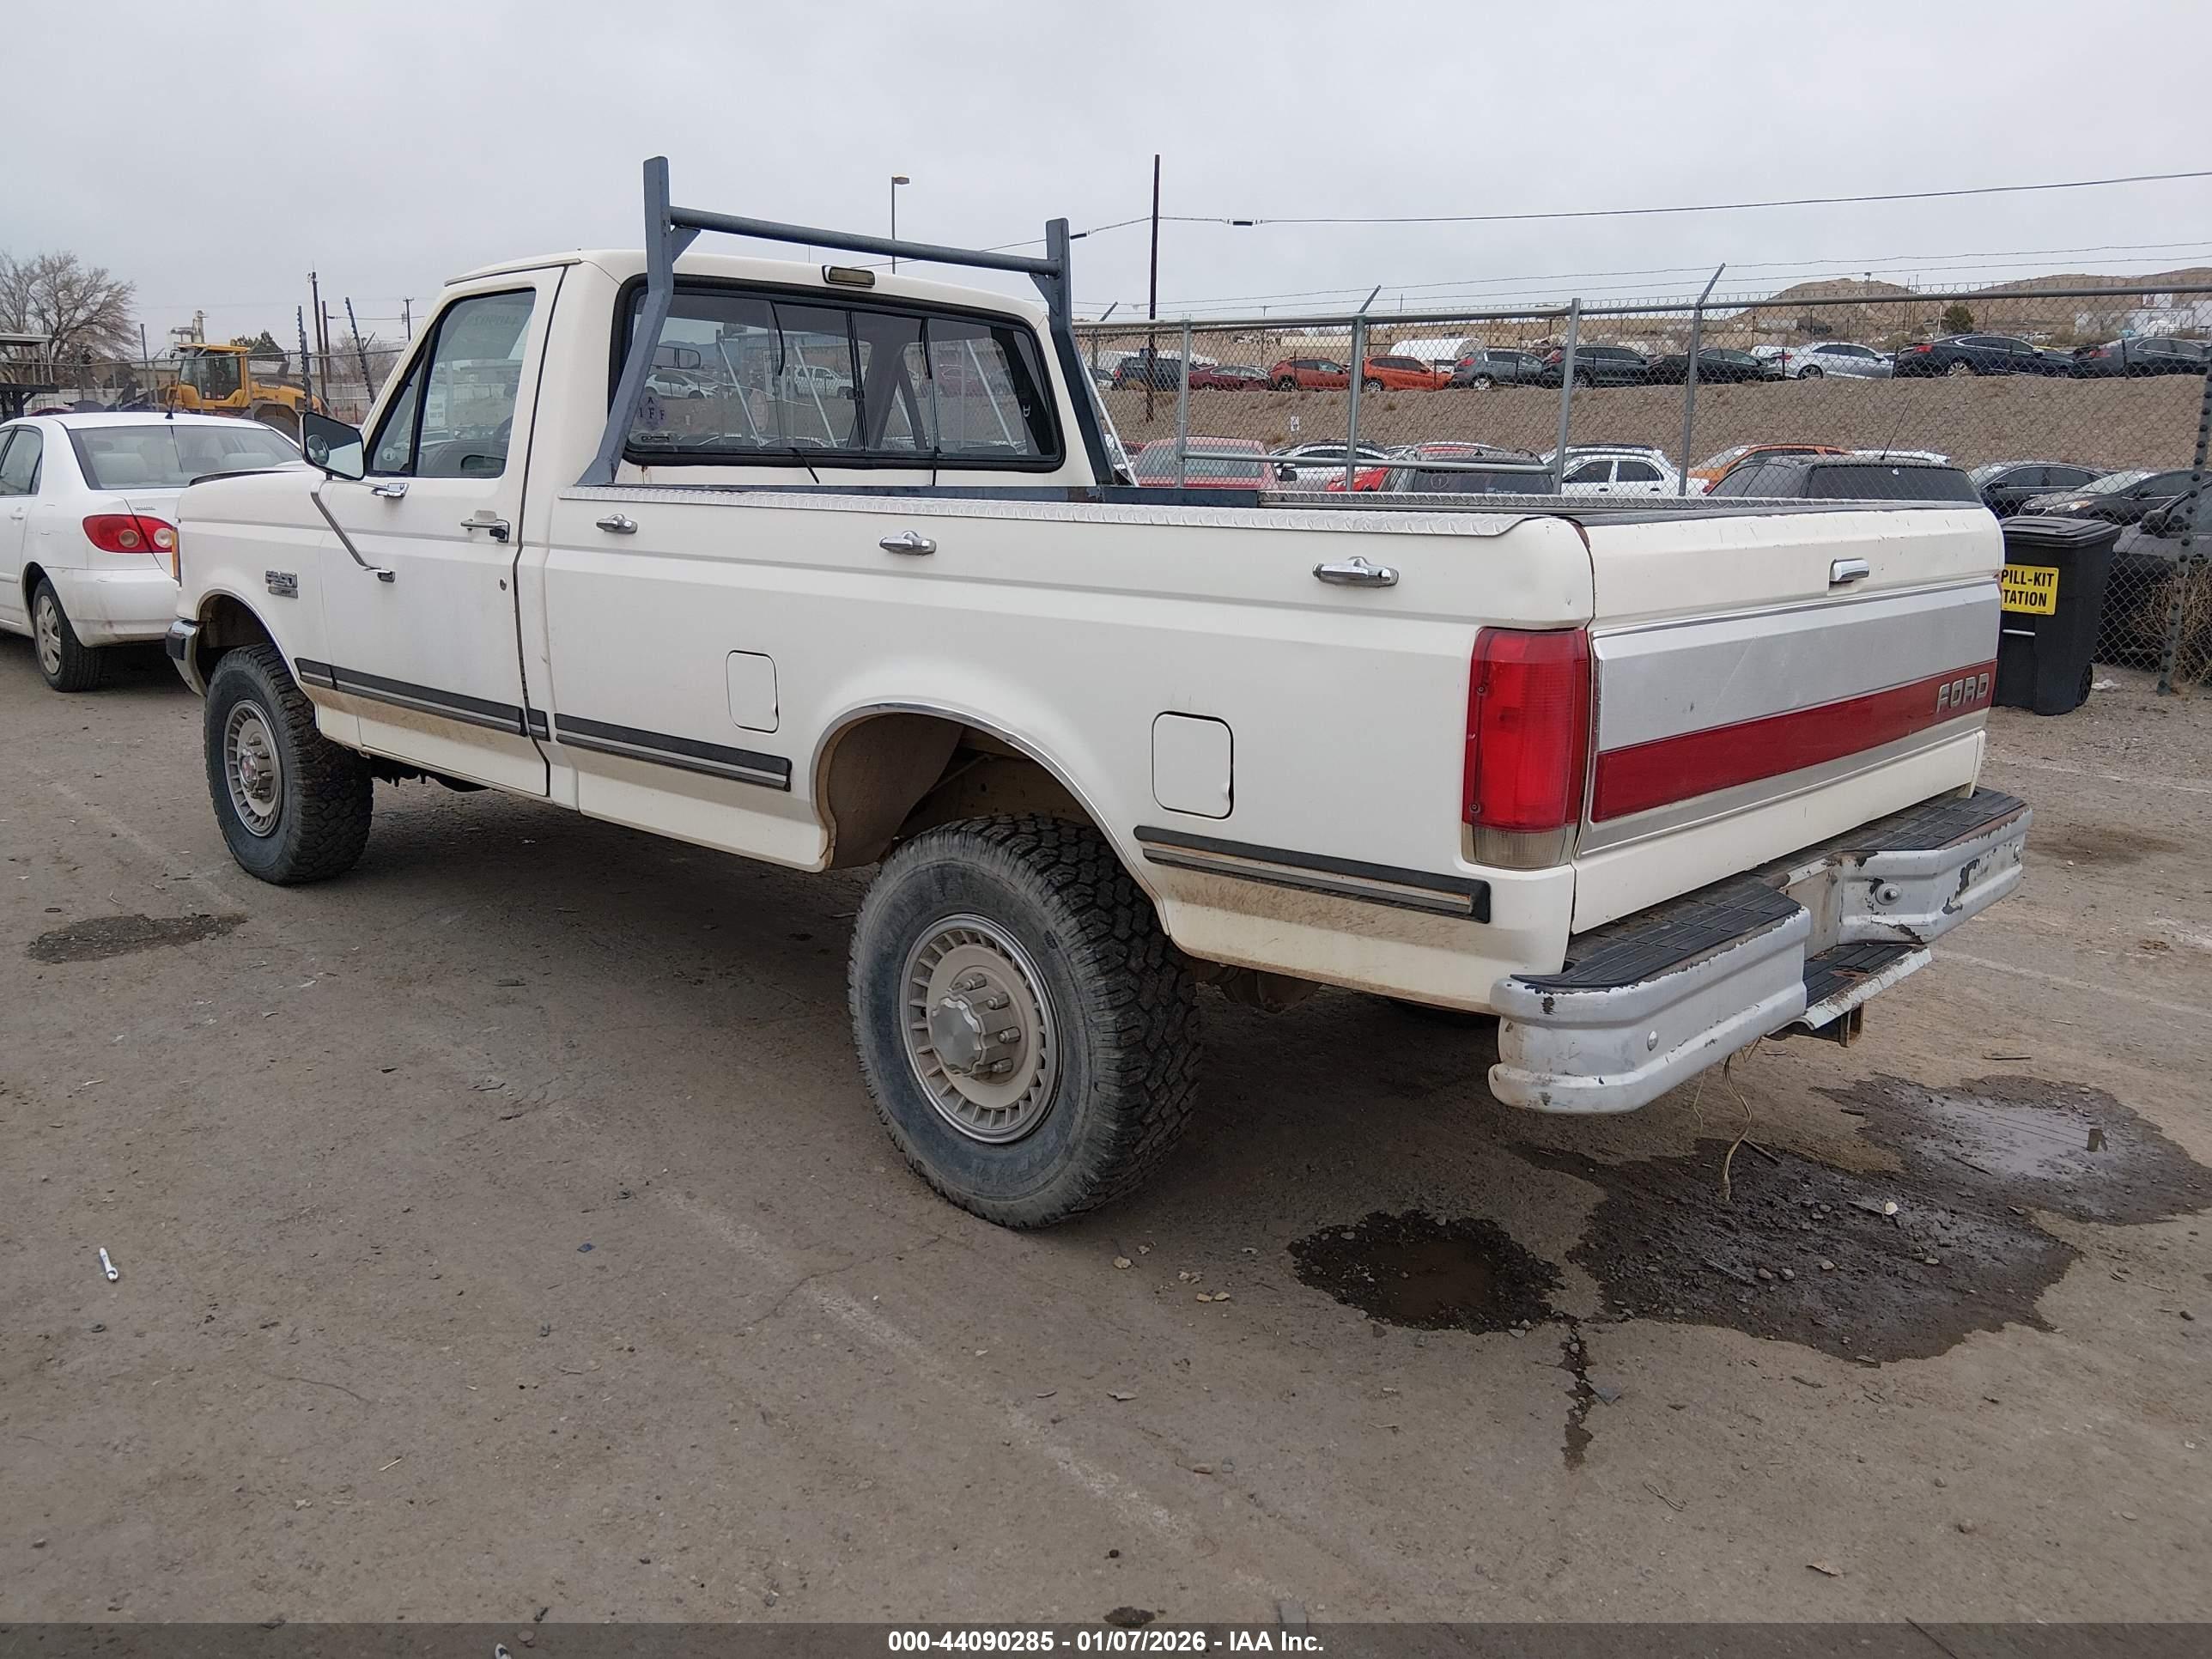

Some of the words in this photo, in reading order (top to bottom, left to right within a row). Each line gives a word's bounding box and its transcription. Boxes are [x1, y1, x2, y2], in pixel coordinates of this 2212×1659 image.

[2001, 569, 2054, 586] PILL-KIT
[2003, 589, 2047, 607] TATION
[1936, 673, 1990, 714] FORD
